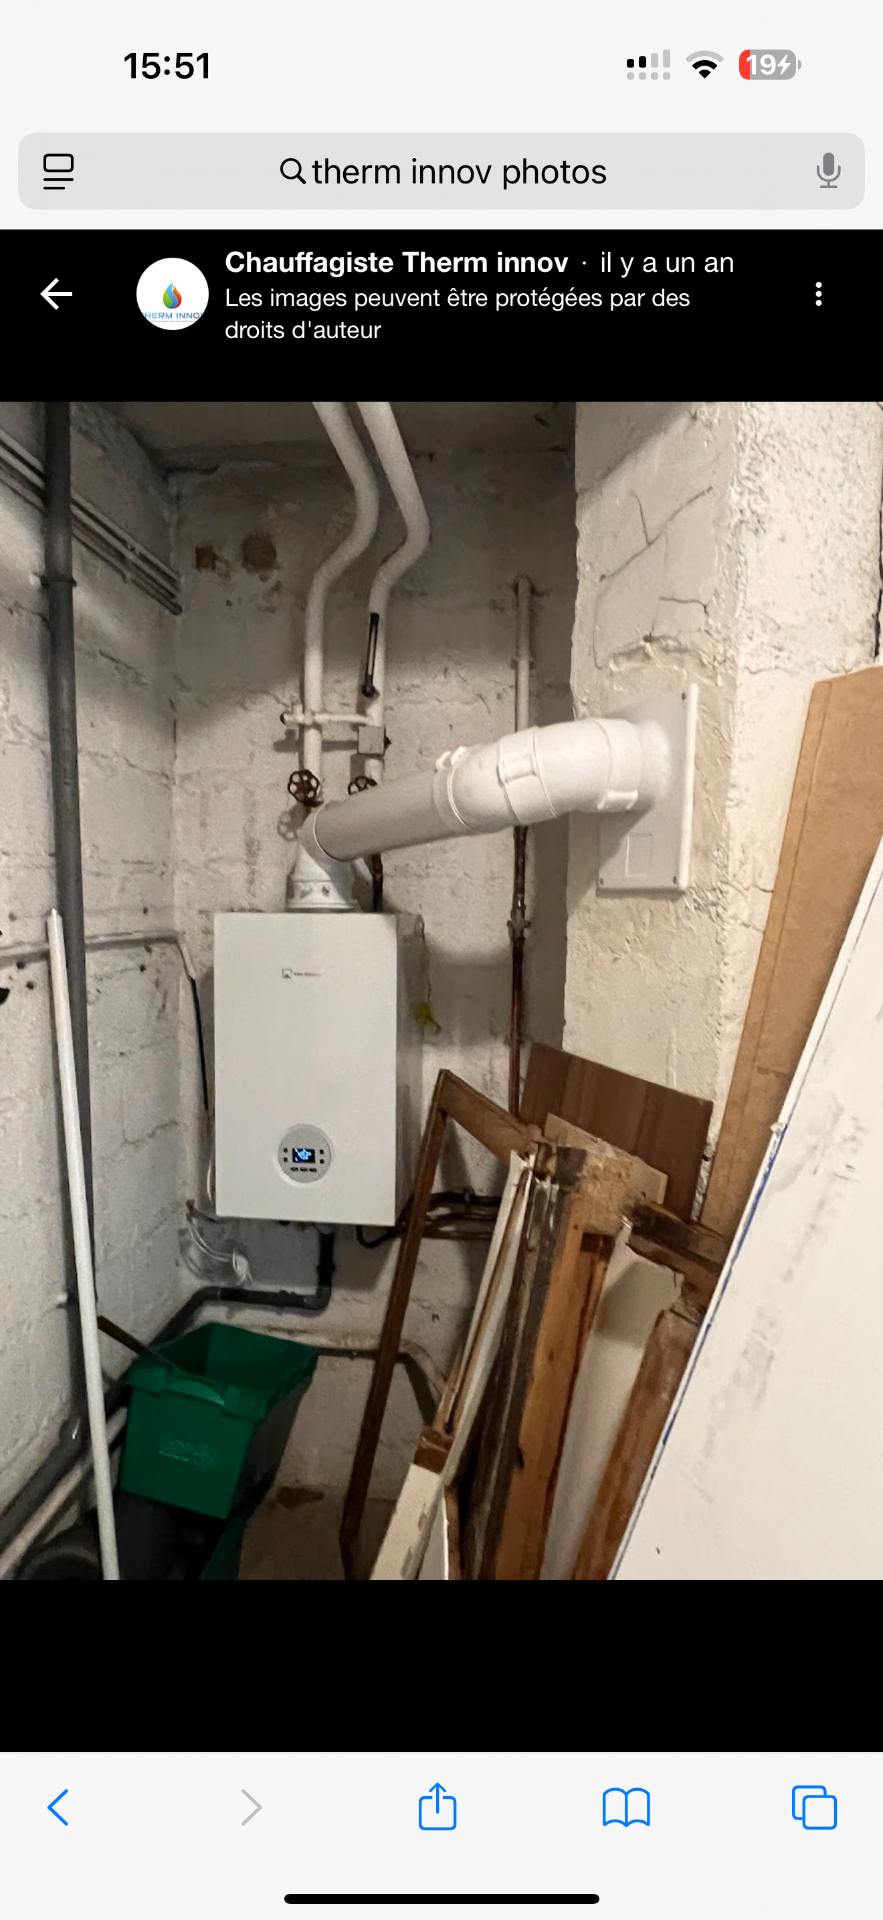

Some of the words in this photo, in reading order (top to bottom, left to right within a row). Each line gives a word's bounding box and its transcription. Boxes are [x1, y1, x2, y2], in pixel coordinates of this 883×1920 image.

[123, 52, 209, 80] 15:51
[746, 54, 776, 75] 19
[311, 157, 401, 185] therm
[411, 157, 492, 185] innov
[503, 157, 607, 190] photos
[225, 250, 394, 278] Chauffagiste
[401, 251, 488, 273] Therm
[497, 251, 569, 273] innov
[600, 251, 611, 273] il
[620, 256, 635, 279] y
[642, 256, 658, 273] a
[666, 256, 695, 273] un
[704, 256, 734, 273] an
[226, 288, 263, 307] Les
[270, 288, 347, 312] images
[354, 289, 441, 312] peuvent
[447, 287, 488, 307] être
[496, 286, 603, 312] protégées
[610, 292, 646, 312] par
[651, 288, 691, 307] des
[225, 320, 285, 339] droits
[291, 320, 382, 339] d'auteur
